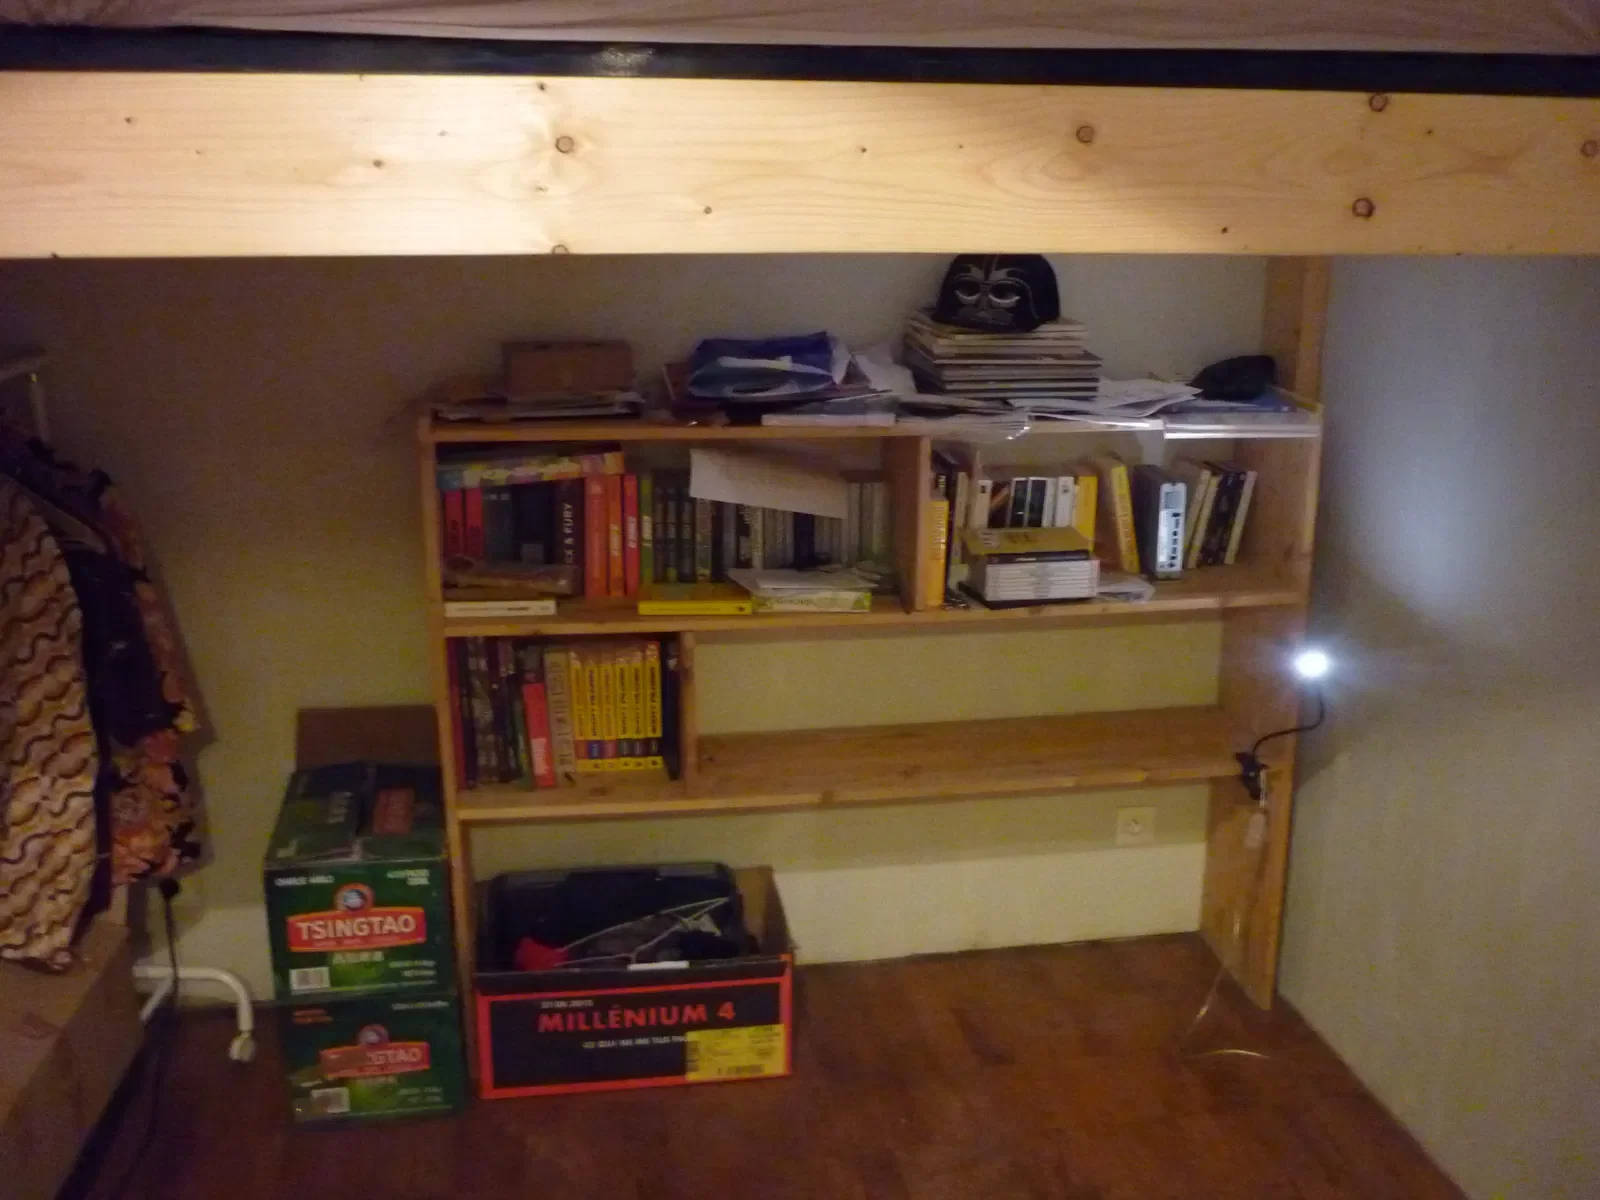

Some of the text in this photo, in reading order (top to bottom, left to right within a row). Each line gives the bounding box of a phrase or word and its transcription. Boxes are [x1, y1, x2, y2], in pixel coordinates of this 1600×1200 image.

[563, 503, 573, 534] FURY
[297, 914, 416, 940] TSINGTAO
[717, 1002, 736, 1020] 4
